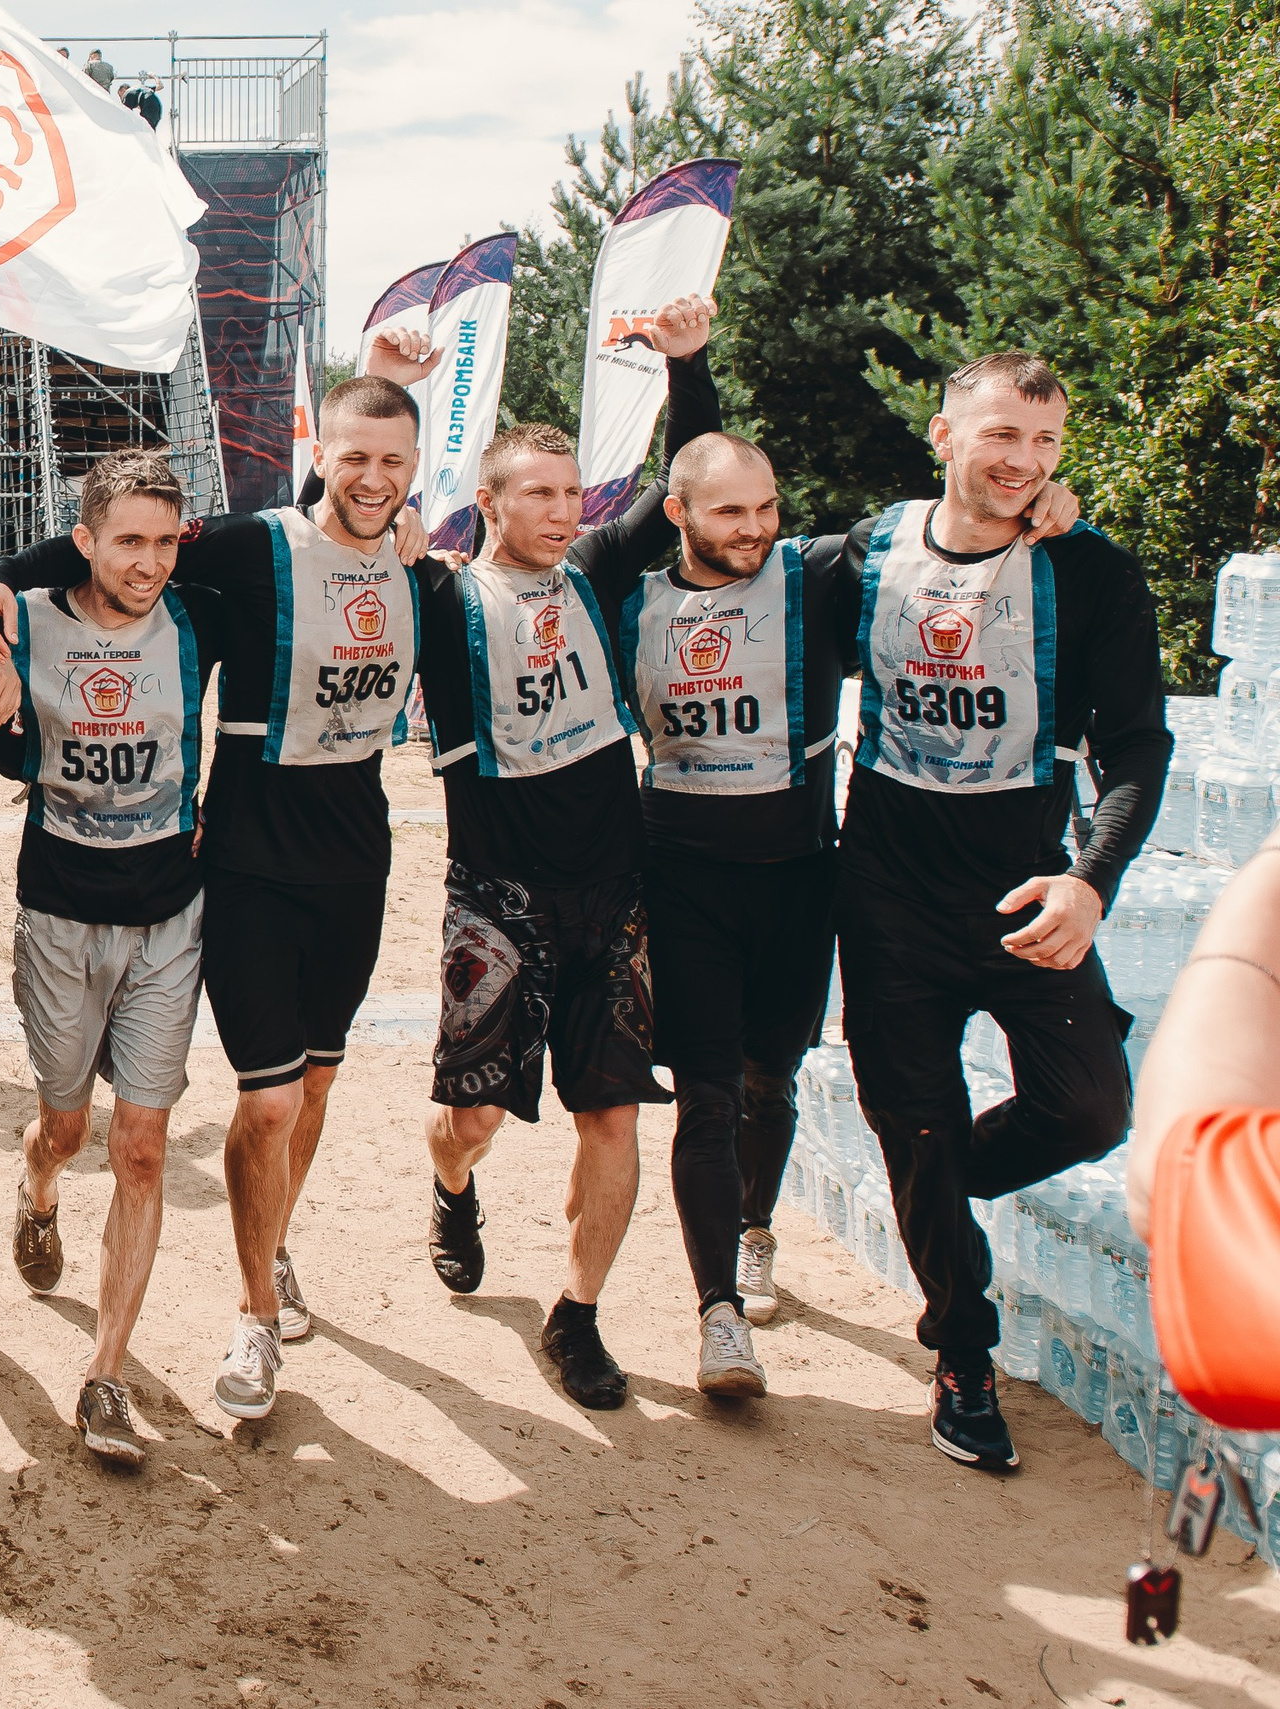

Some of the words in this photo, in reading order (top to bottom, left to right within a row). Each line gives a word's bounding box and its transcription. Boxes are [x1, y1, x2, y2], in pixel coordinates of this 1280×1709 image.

[596, 353, 611, 362] HIT
[611, 356, 637, 370] MUSIC
[637, 364, 659, 376] ONLY
[446, 319, 478, 454] ГАЗПРОМБАНК
[332, 572, 365, 583] ГОНКА
[516, 589, 548, 602] ГОНКА
[916, 587, 950, 600] ГОНКА
[672, 615, 704, 625] ГОНКА
[706, 608, 744, 619] ГЕРОЕВ
[66, 651, 100, 660] ГОНКА
[103, 650, 141, 660] ГЕРОЕВ
[332, 641, 394, 660] ПИВТОЧКА
[905, 659, 986, 681] ПИВТОЧКА
[315, 660, 401, 709] 5306
[668, 675, 743, 697] ПИВТОЧКА
[895, 677, 1007, 731] 5309
[659, 695, 760, 738] 5310
[71, 720, 145, 737] ПИВТОЧКА
[547, 719, 596, 746] ГАЗПРОМБАНК
[61, 739, 159, 785] 5307
[694, 762, 754, 772] ГАЗПРОМБАНК
[925, 754, 994, 770] ГАЗПРОМБАНК
[92, 810, 152, 822] ГАЗПРОМБАНК
